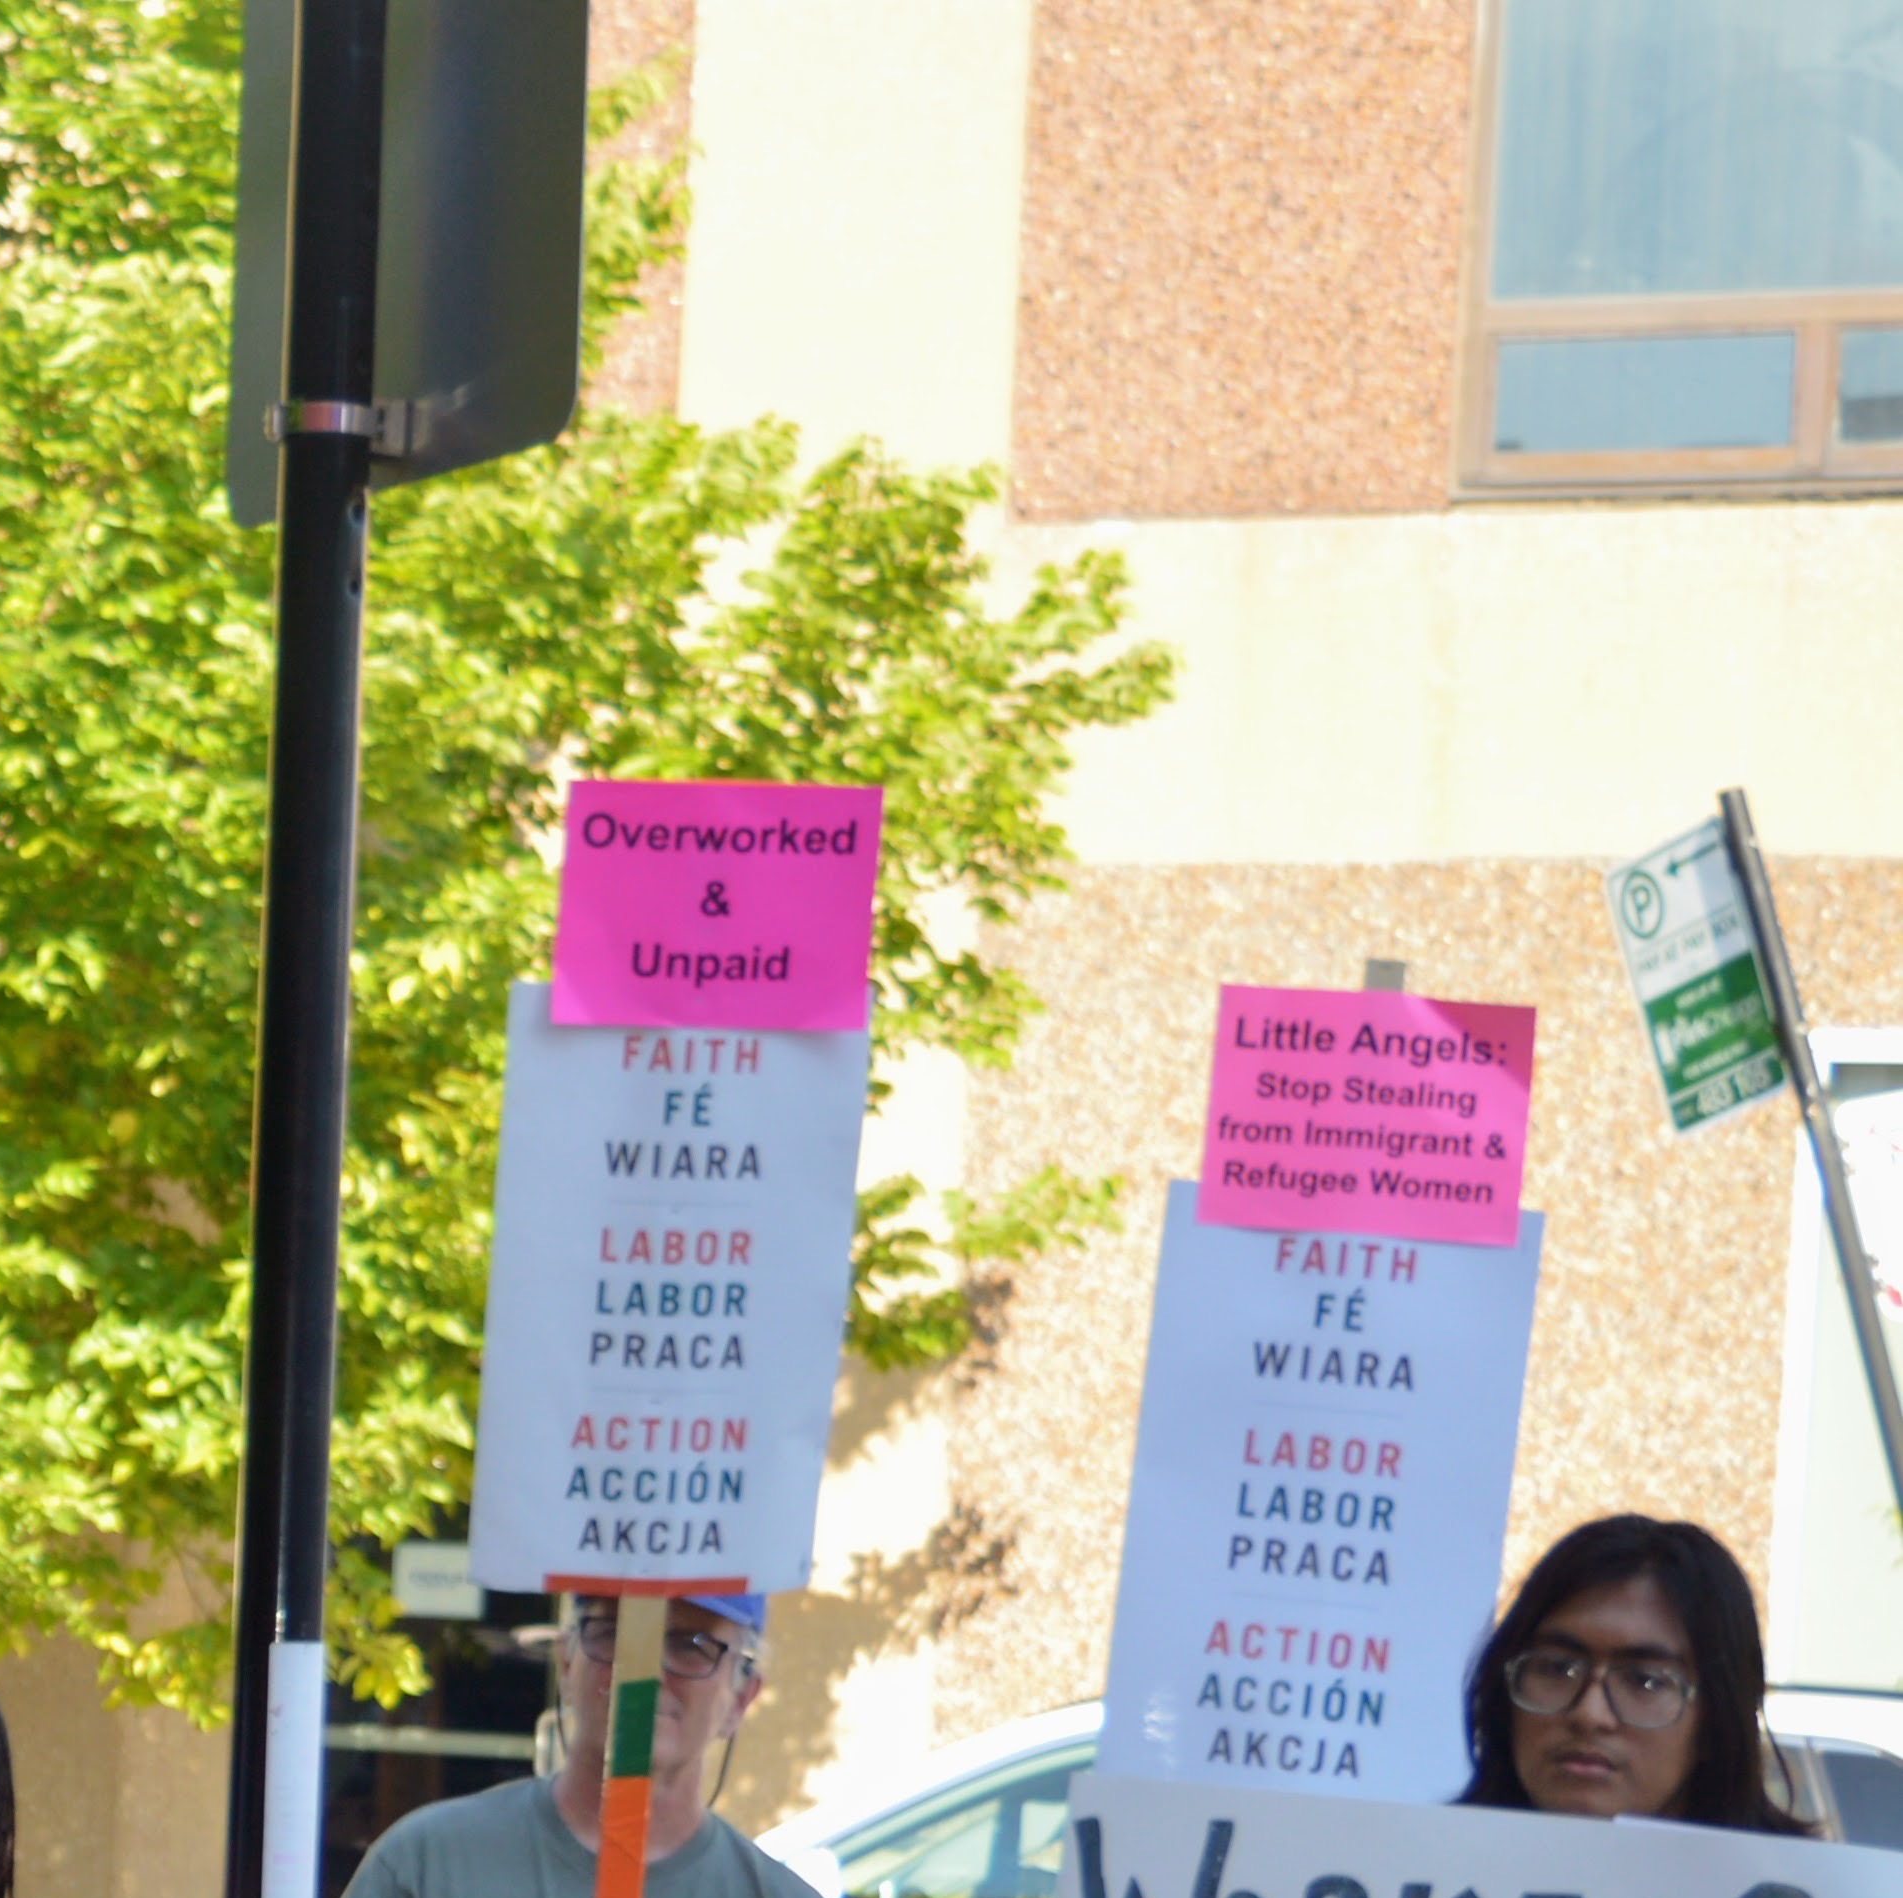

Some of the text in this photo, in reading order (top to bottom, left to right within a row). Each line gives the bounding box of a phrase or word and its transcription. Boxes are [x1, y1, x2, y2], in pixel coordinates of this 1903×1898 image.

[583, 812, 857, 854] Overworked
[700, 880, 730, 917] &
[631, 942, 791, 988] Unpaid
[623, 1035, 762, 1074] FAITH
[1235, 1016, 1507, 1067] Little Angels:
[663, 1083, 713, 1127] FÉ
[1256, 1072, 1477, 1118] Stop Stealing
[605, 1140, 762, 1180] WIARA
[1219, 1115, 1507, 1160] from Immigrant &
[1223, 1160, 1494, 1203] Refugee Women
[600, 1228, 753, 1267] LABOR
[1275, 1237, 1417, 1284] FAITH
[597, 1280, 748, 1318] LABOR
[1314, 1288, 1365, 1333] FÉ
[590, 1332, 745, 1370] PRACA
[1252, 1341, 1415, 1392] WIARA
[571, 1415, 748, 1452] ACTION
[1243, 1429, 1403, 1479] LABOR
[566, 1460, 744, 1505] ACCIÓN
[1237, 1482, 1395, 1533] LABOR
[578, 1518, 724, 1555] AKCJA
[1227, 1536, 1391, 1586] PRACA
[1205, 1619, 1391, 1674] ACTION
[1197, 1671, 1385, 1727] ACCIÓN
[1207, 1728, 1361, 1779] AKCJA
